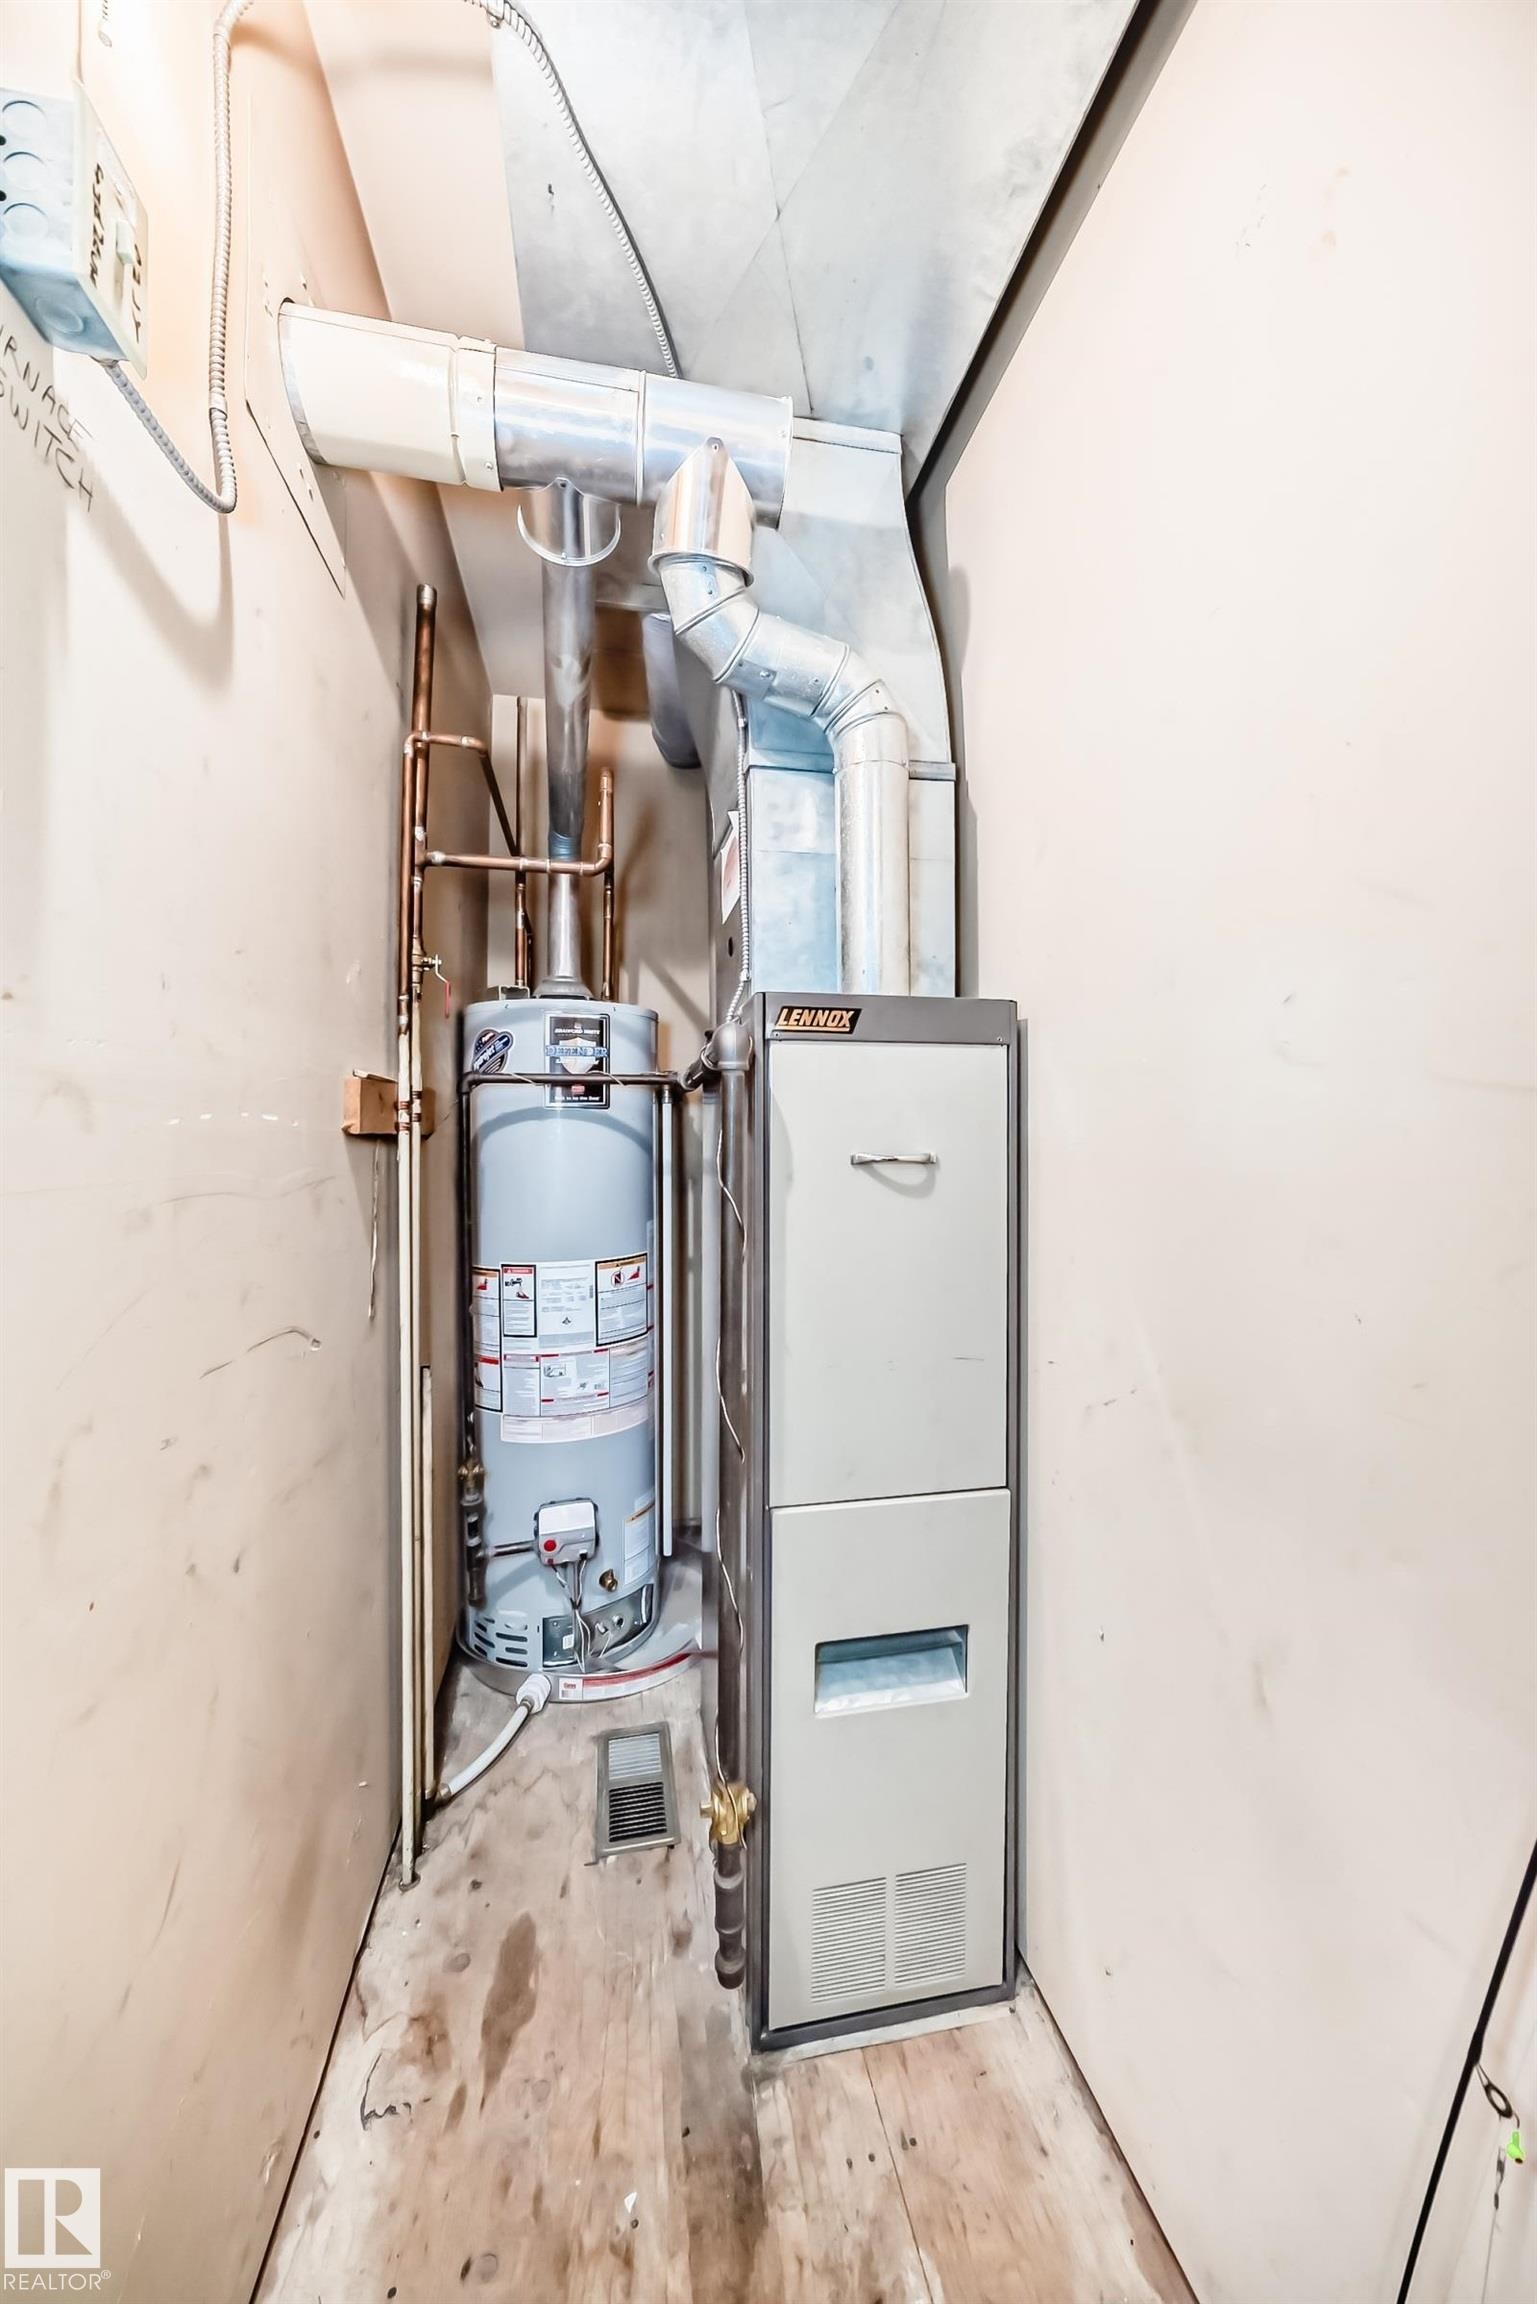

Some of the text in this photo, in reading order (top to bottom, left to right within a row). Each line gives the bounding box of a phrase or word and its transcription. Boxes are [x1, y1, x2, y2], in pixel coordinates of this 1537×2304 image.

[0, 325, 93, 452] RNACE
[778, 1008, 855, 1027] LENNOX
[546, 1045, 608, 1058] DEFENDER
